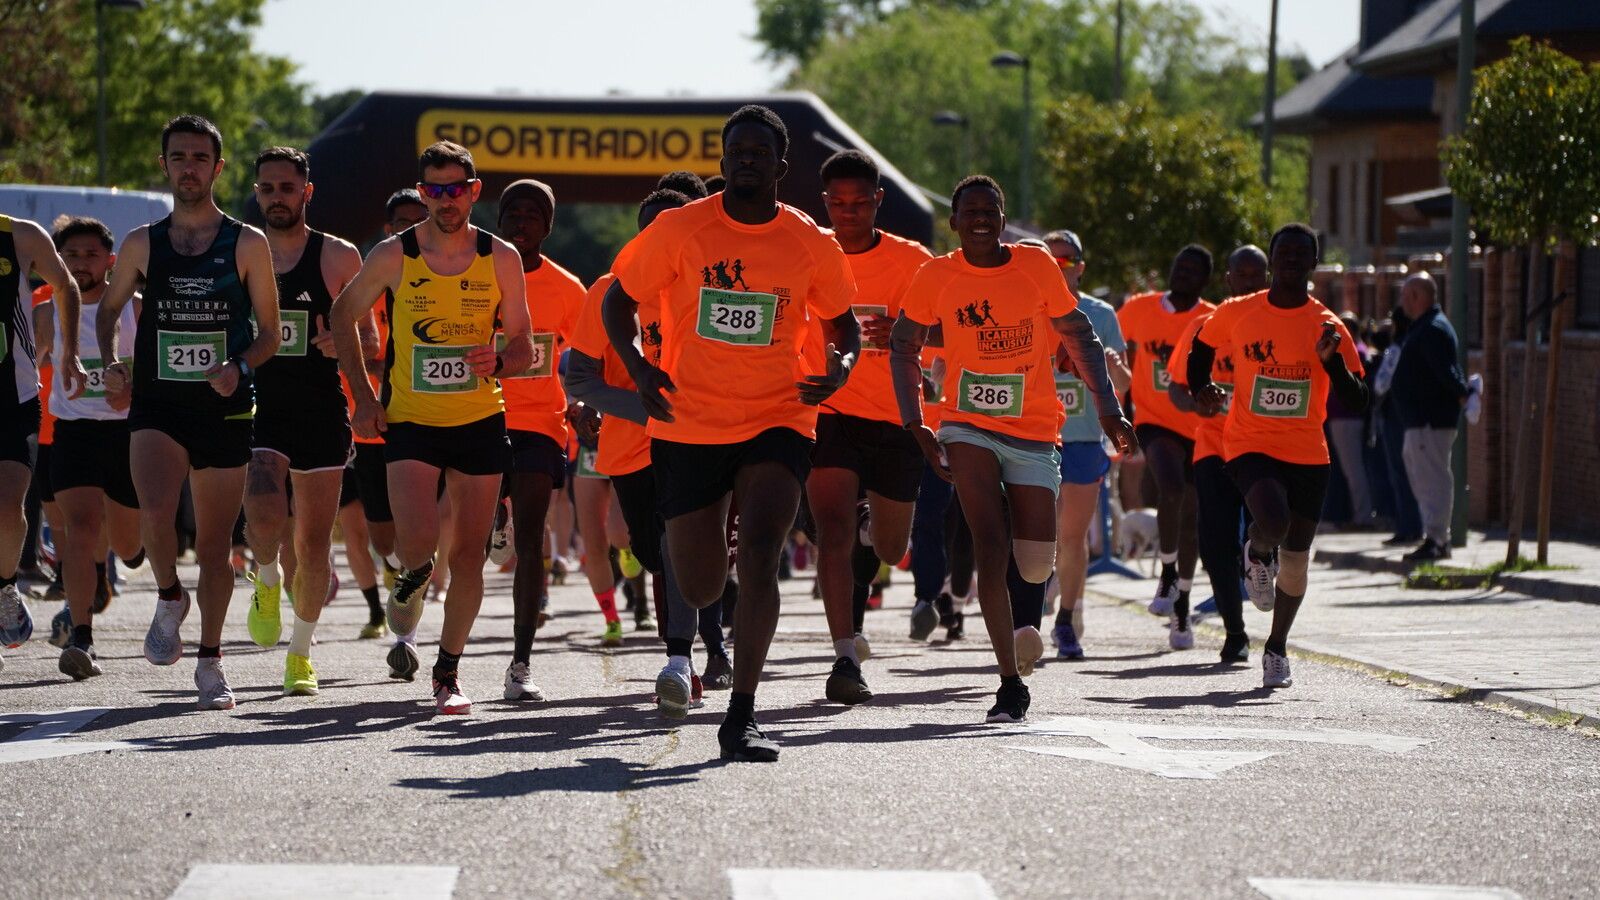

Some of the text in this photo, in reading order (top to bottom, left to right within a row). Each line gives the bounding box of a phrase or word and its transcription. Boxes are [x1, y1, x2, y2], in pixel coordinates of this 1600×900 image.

[158, 301, 228, 310] NOCTURNA
[172, 313, 214, 321] CONSUEGRA
[716, 307, 756, 329] 288
[986, 326, 1033, 340] CARRERA
[979, 335, 1032, 351] INCLUSIVA
[173, 348, 210, 366] 219
[428, 361, 465, 378] 203
[973, 386, 1008, 405] 286
[1265, 391, 1297, 405] 306
